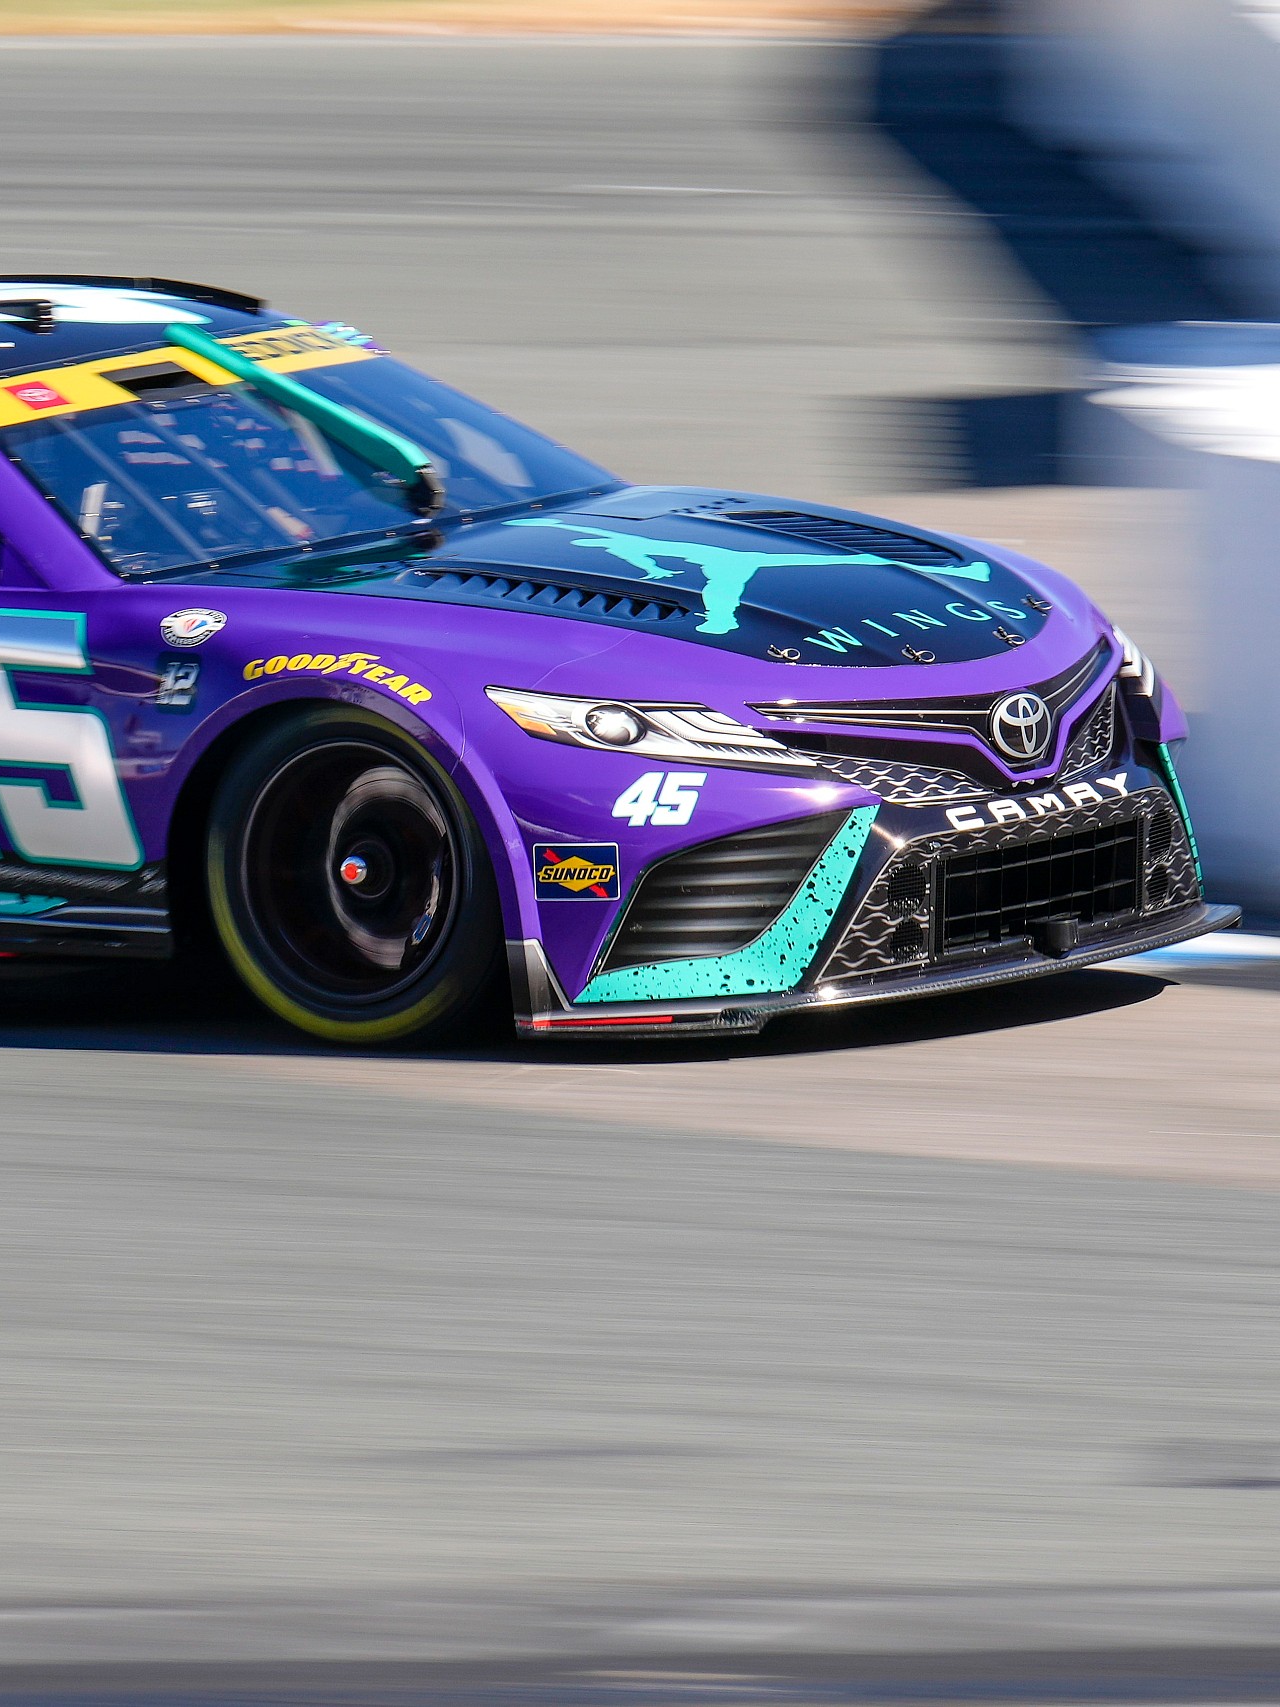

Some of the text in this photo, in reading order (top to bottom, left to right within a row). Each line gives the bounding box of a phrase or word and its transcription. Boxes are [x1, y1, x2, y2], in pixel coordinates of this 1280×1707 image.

[803, 601, 1026, 653] WINGS
[243, 653, 432, 705] GOODYEAR
[611, 771, 708, 826] 45
[945, 772, 1128, 831] CAMRY
[540, 866, 612, 881] SUNOCO
